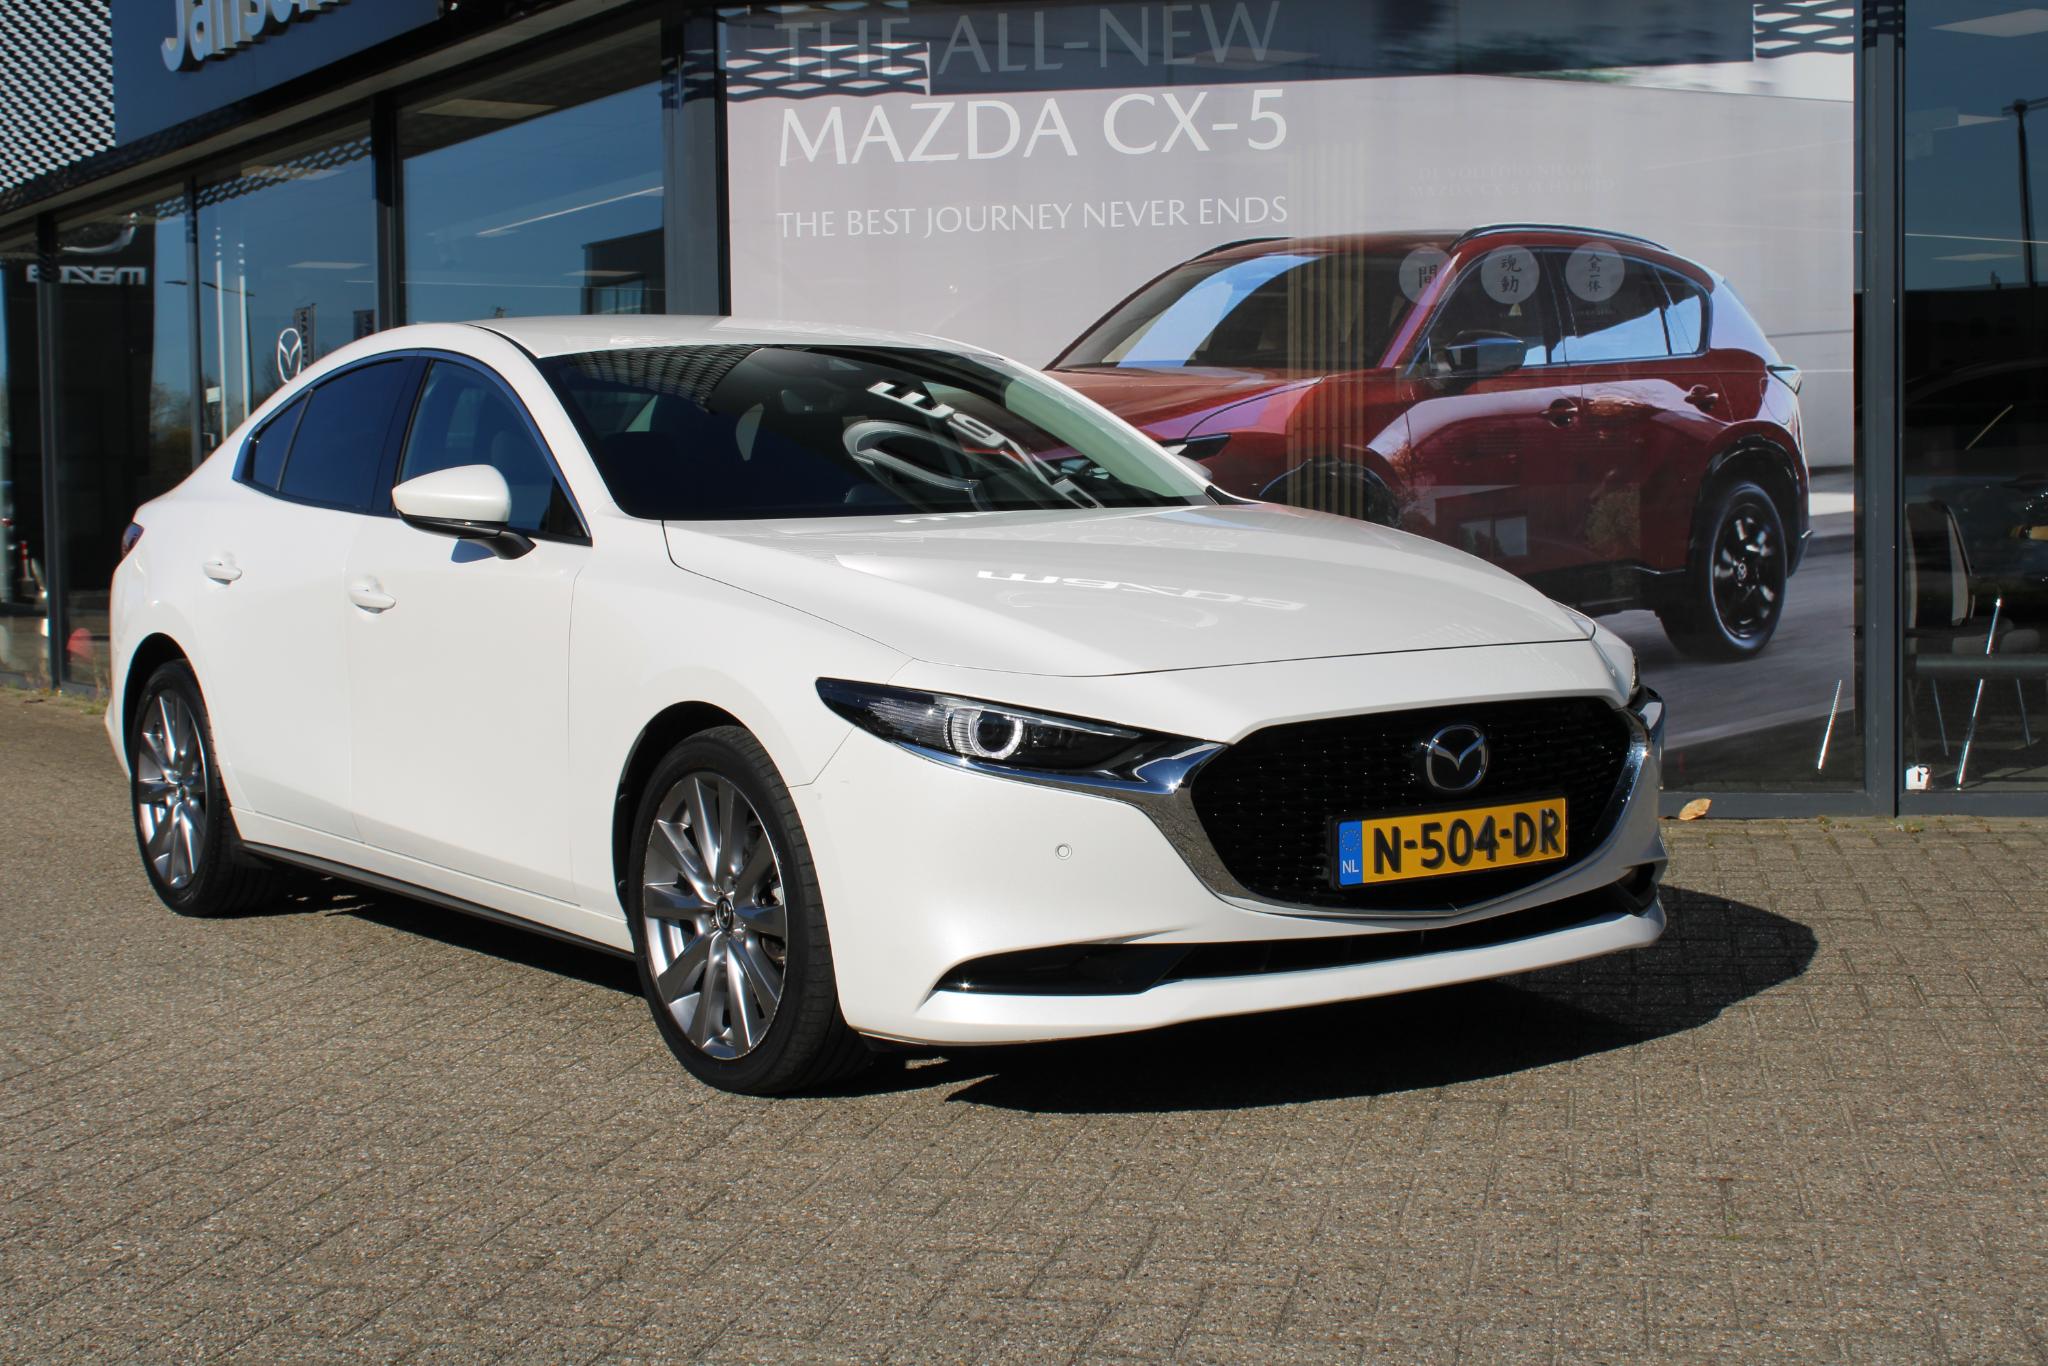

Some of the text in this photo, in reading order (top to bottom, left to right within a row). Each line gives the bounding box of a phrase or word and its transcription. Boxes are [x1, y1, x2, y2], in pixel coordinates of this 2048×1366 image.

[161, 0, 340, 72] Jans
[774, 1, 1280, 81] THE ALL-NEW
[780, 88, 1287, 167] MAZDA CX-5
[776, 195, 1288, 239] THE BEST JOURNEY NEVER ENDS
[1342, 808, 1562, 875] NL N-504-DR
